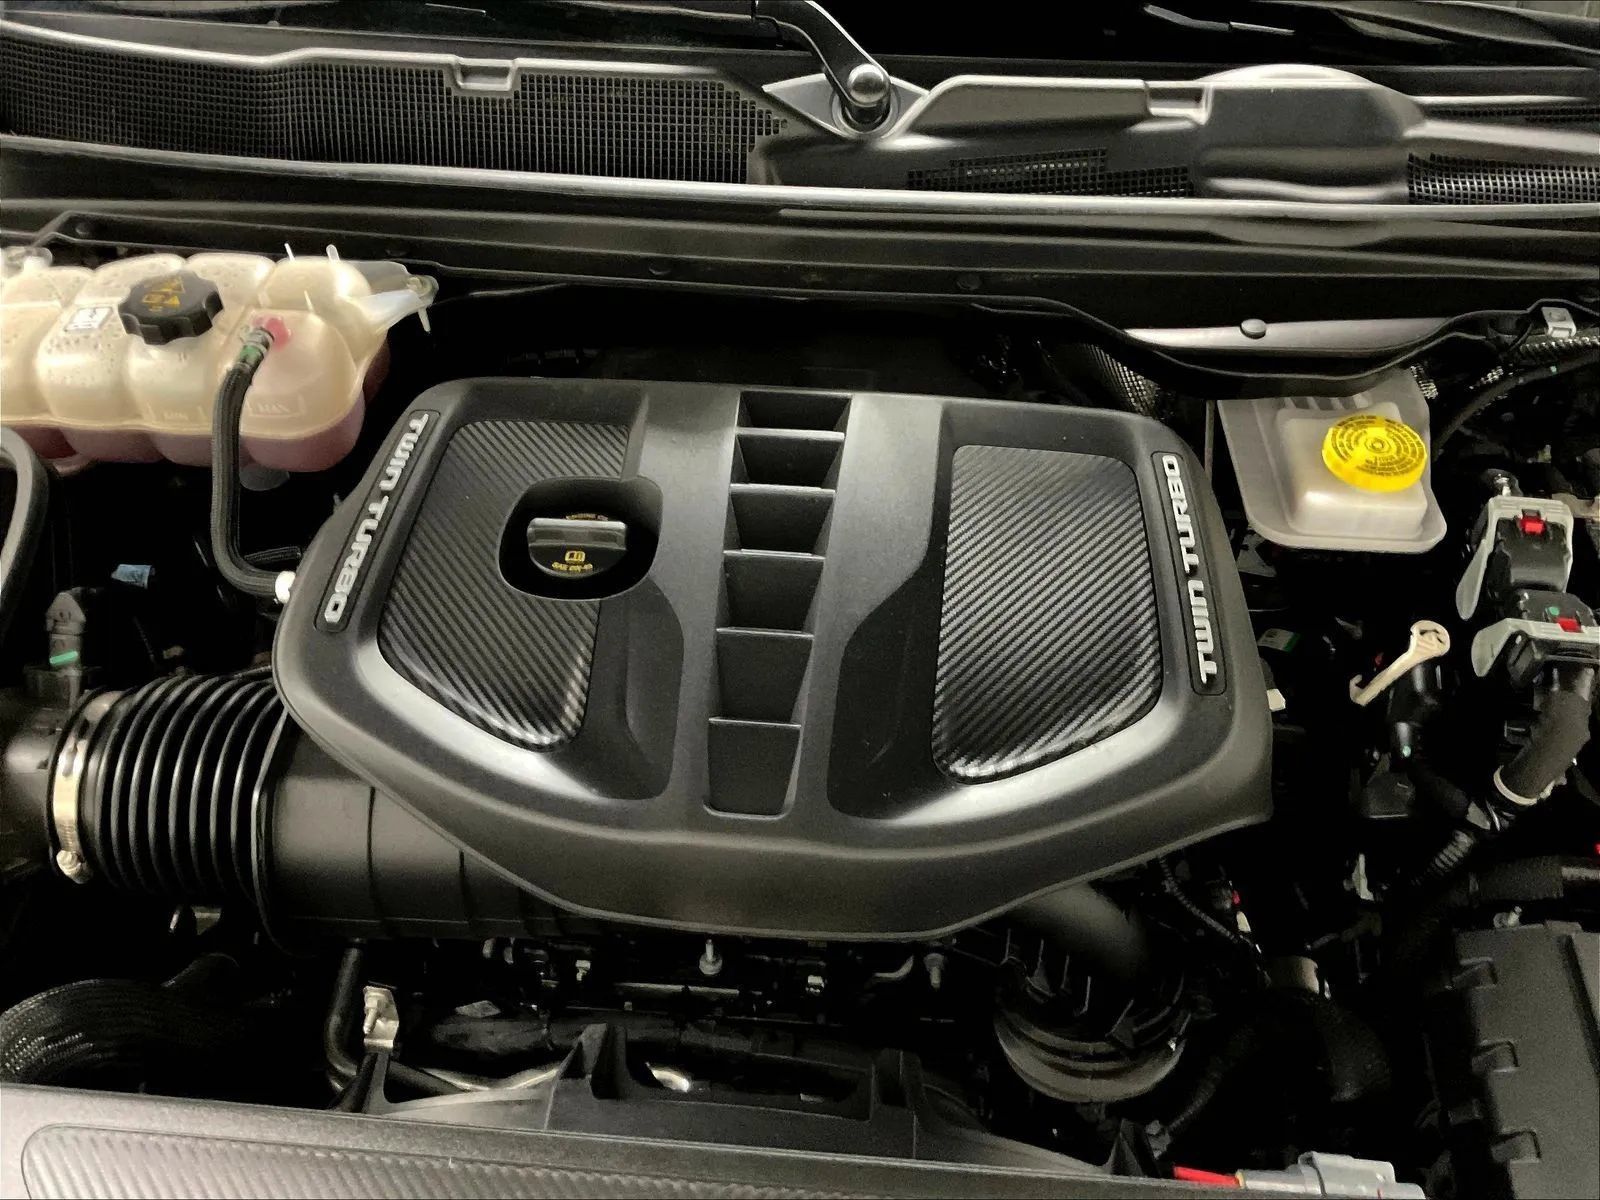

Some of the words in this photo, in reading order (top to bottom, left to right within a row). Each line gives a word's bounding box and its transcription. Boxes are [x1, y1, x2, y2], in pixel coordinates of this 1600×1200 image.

[379, 413, 429, 491] TWIN
[324, 495, 389, 623] TURBO
[1162, 454, 1199, 573] TURBO
[1188, 579, 1217, 684] TWIN
